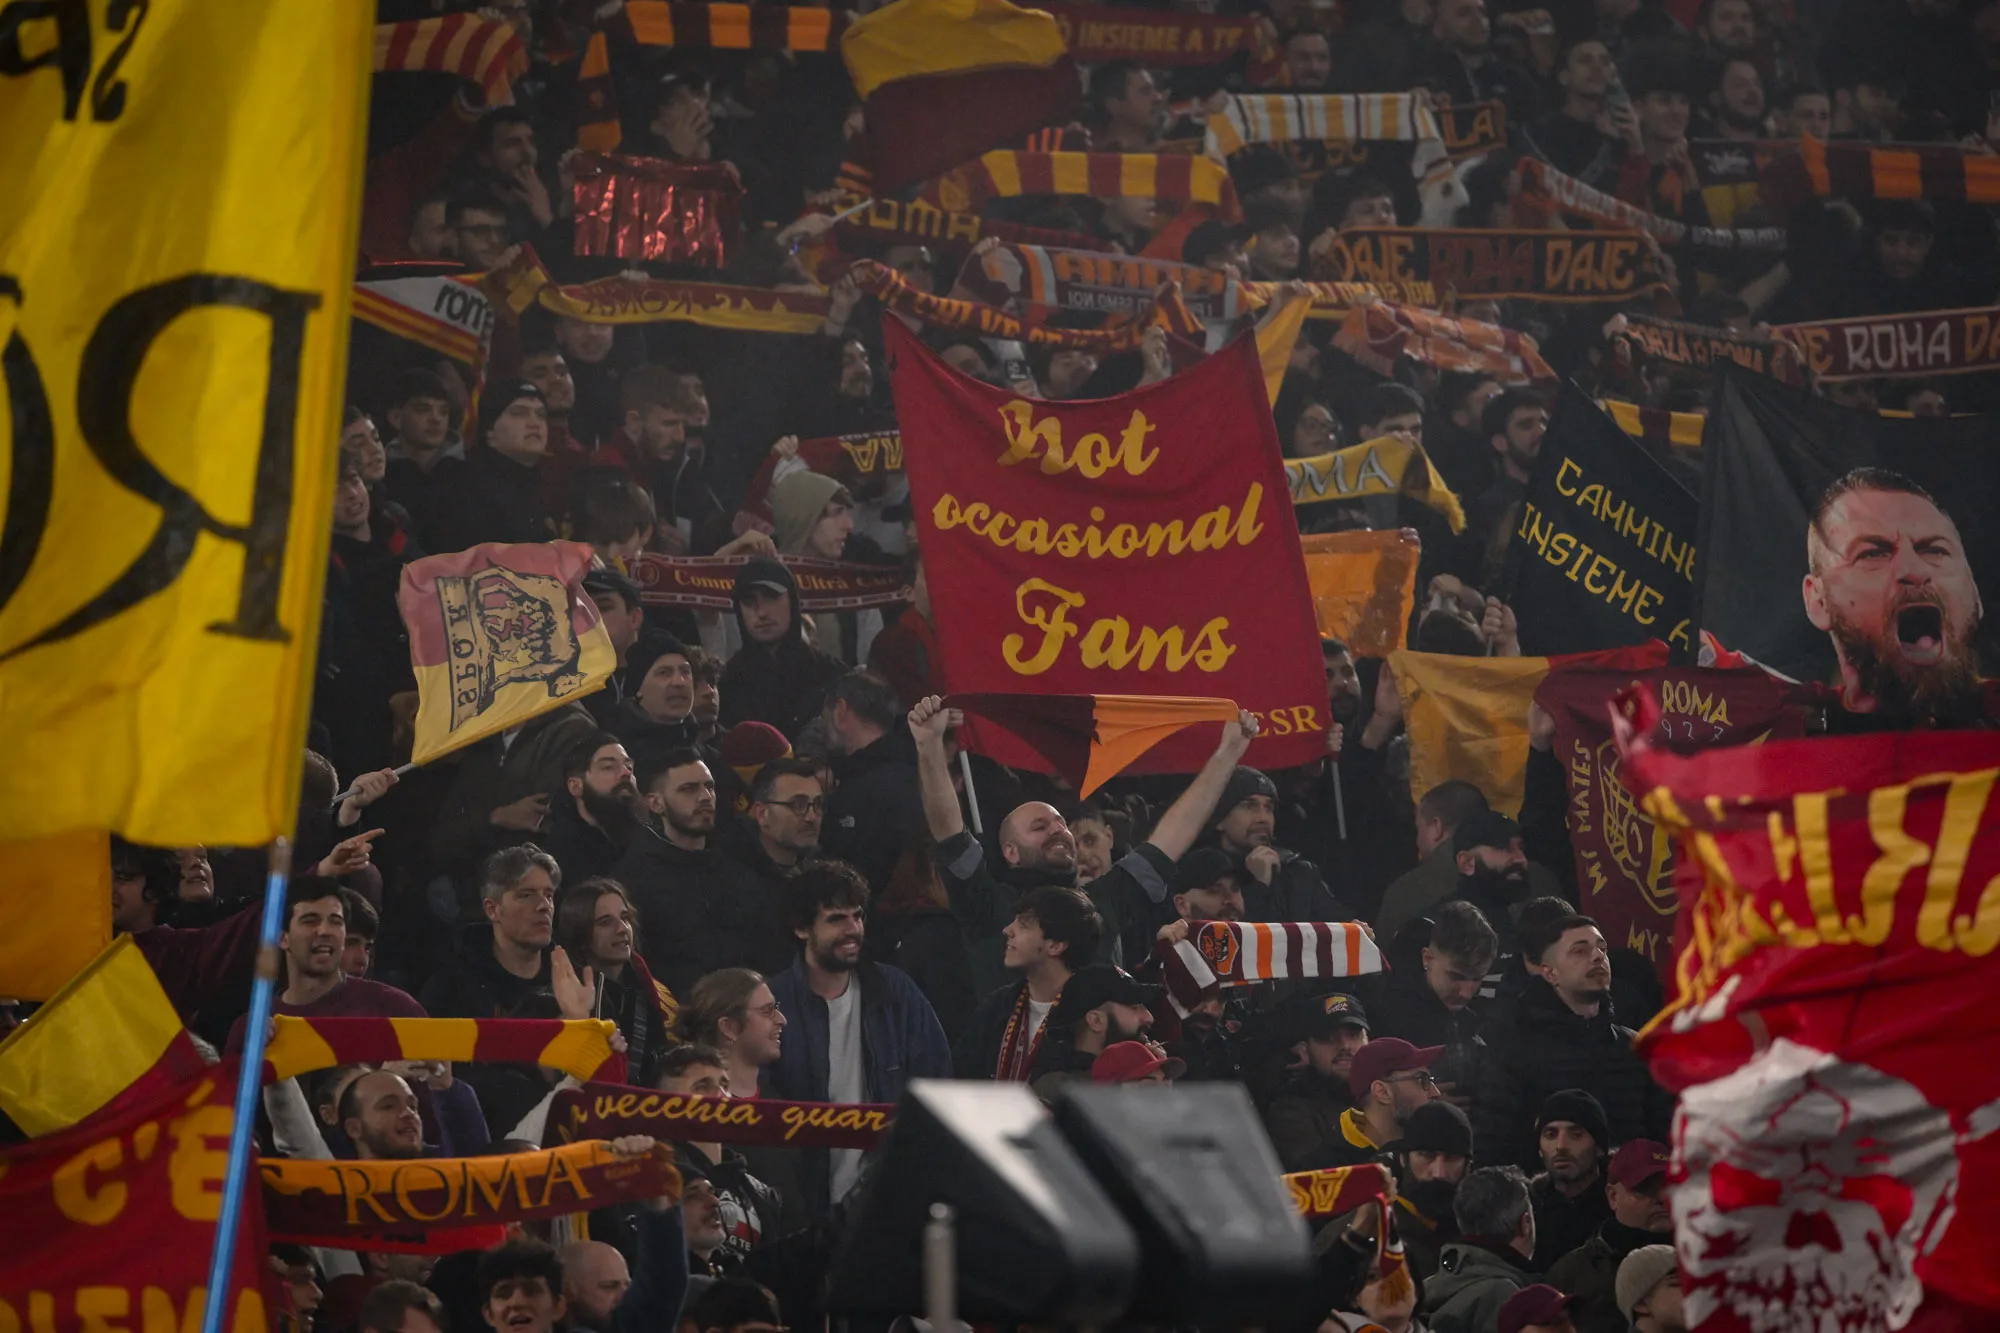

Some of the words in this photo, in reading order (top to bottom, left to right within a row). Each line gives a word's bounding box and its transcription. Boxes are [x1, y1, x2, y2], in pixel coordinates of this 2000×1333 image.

[1544, 241, 1637, 292] DAJE
[1844, 319, 1951, 369] ROMA
[996, 399, 1160, 477] Not
[932, 481, 1263, 557] occasional
[1517, 502, 1665, 625] INSIEME
[1002, 576, 1237, 674] Fans
[1662, 680, 1733, 727] ROMA
[594, 1093, 762, 1125] vecchia
[329, 1152, 593, 1225] ROMA
